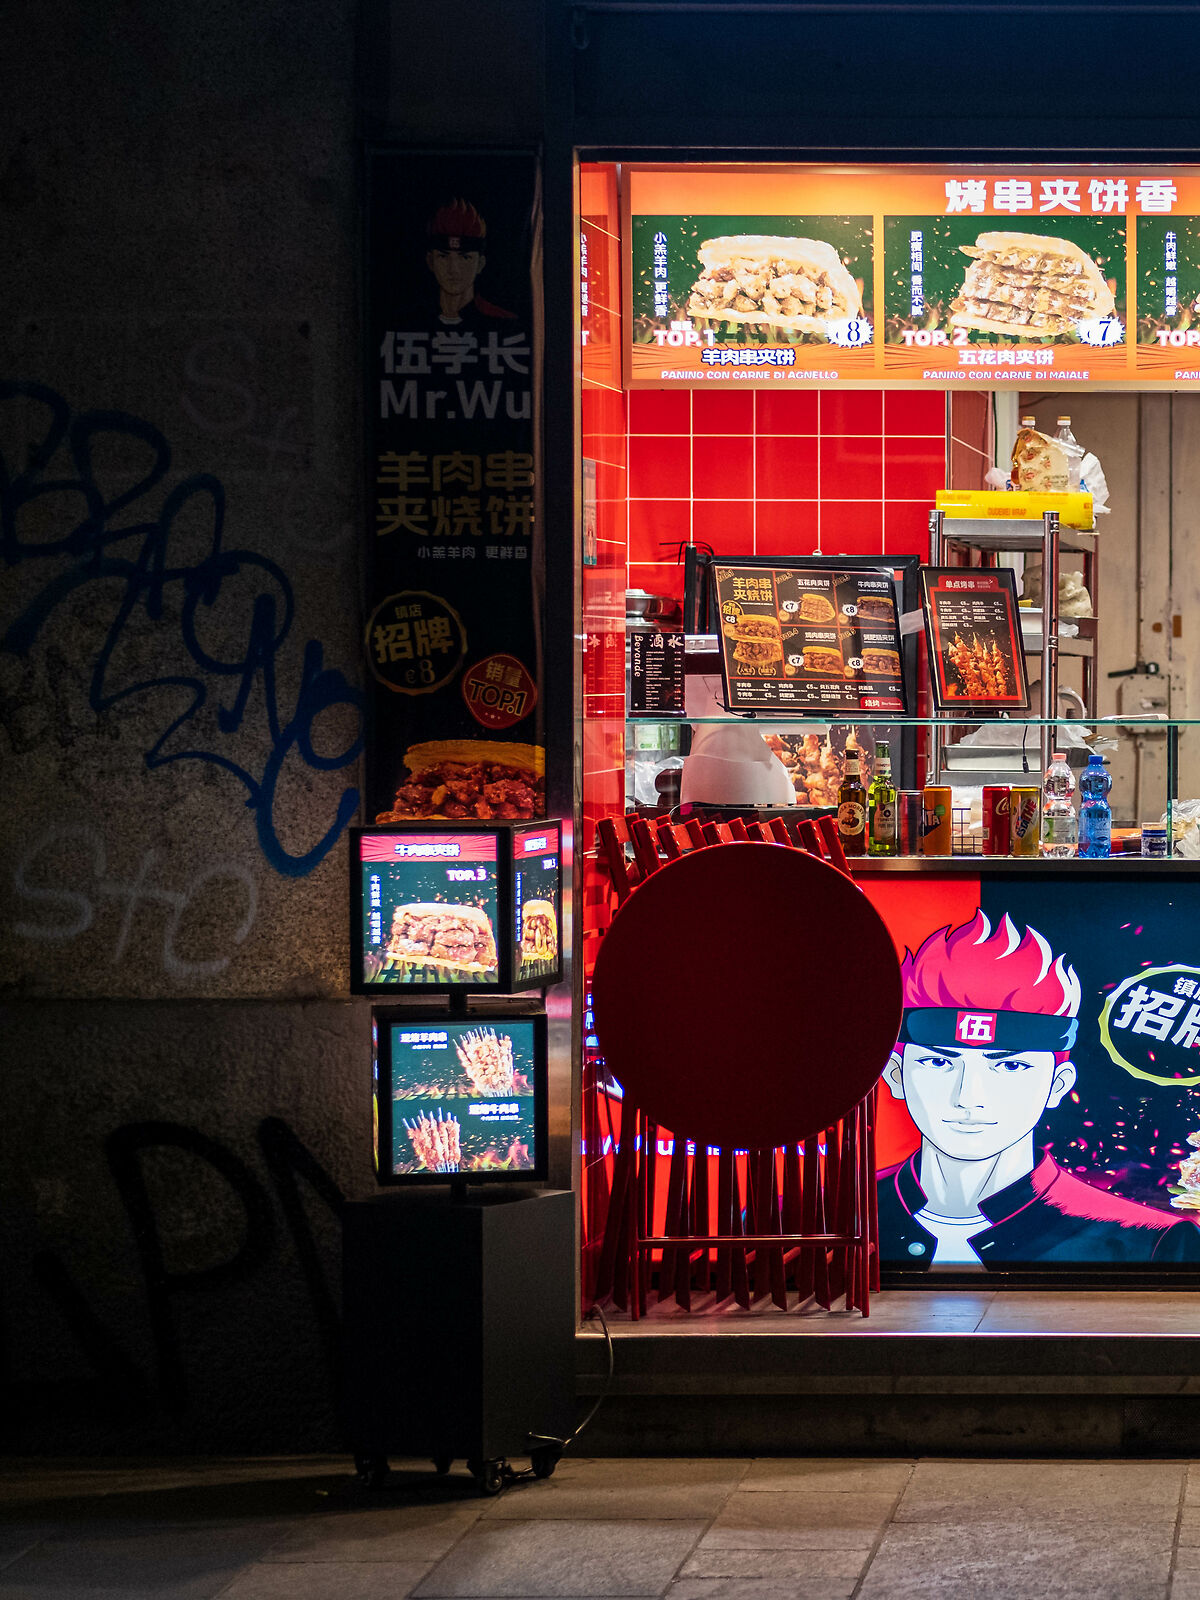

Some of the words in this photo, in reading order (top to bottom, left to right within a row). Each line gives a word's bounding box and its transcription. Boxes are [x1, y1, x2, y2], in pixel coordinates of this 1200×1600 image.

[944, 178, 1178, 214] 烤串夹饼香
[380, 331, 531, 375] 伍学长
[702, 349, 796, 366] 羊肉串夹饼
[958, 350, 1054, 366] 五花肉夹饼
[661, 370, 704, 380] PANINO
[706, 370, 730, 380] CON
[732, 370, 771, 380] CARNE
[773, 370, 786, 380] DI
[788, 370, 839, 380] AGNELLO
[923, 370, 967, 380] PANINO
[968, 370, 993, 380] CON
[994, 370, 1033, 380] CARNE
[1035, 370, 1047, 380] DI
[1049, 370, 1090, 380] MAIALE
[380, 380, 532, 420] Mr.Wu
[376, 450, 535, 492] 羊肉串
[376, 495, 536, 537] 夹烧饼
[732, 577, 772, 590] 羊肉串
[733, 589, 773, 602] 夹烧饼
[374, 616, 455, 664] 招牌
[634, 634, 644, 678] Bevande
[469, 679, 529, 717] TOP.1
[958, 1014, 994, 1042] 伍
